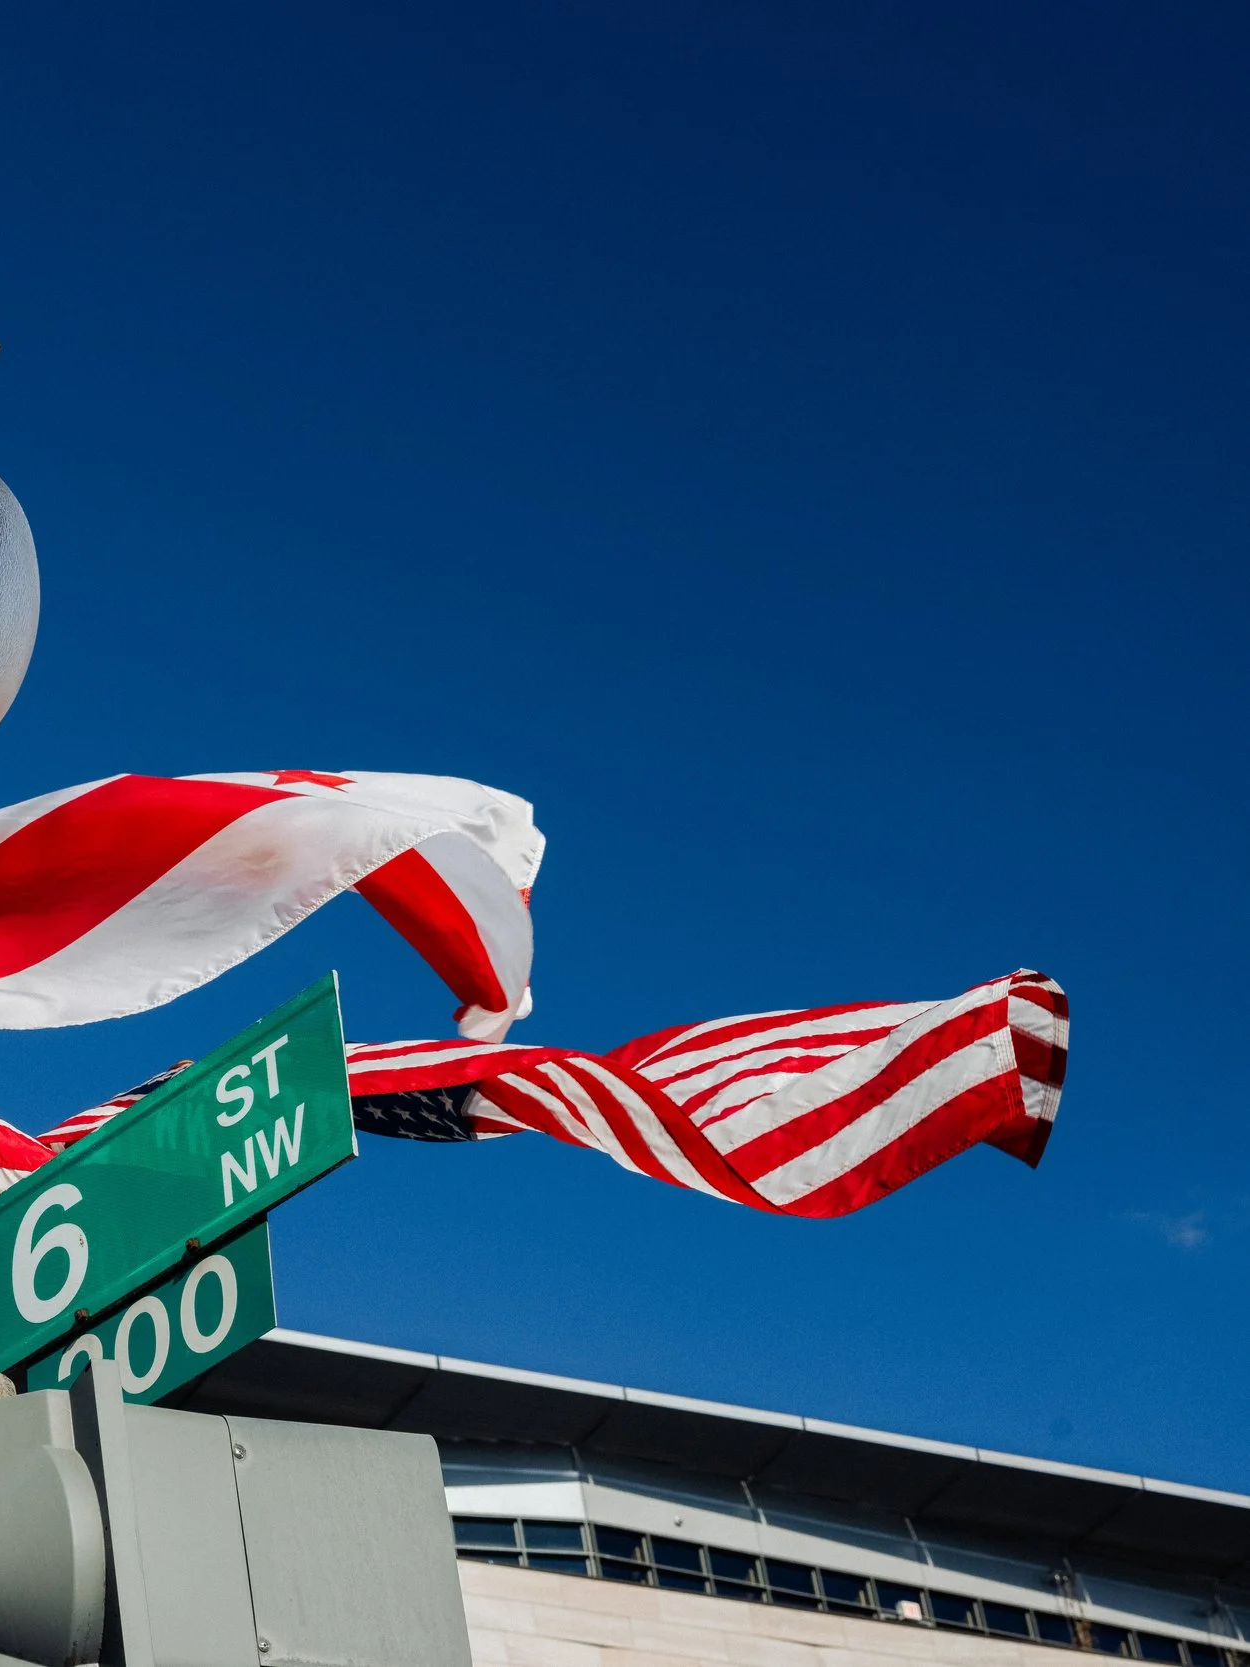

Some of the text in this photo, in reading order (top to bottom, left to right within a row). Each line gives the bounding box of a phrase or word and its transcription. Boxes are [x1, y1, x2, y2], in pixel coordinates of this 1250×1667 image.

[215, 1034, 289, 1128] ST
[220, 1103, 306, 1208] NW
[12, 1183, 89, 1324] 6
